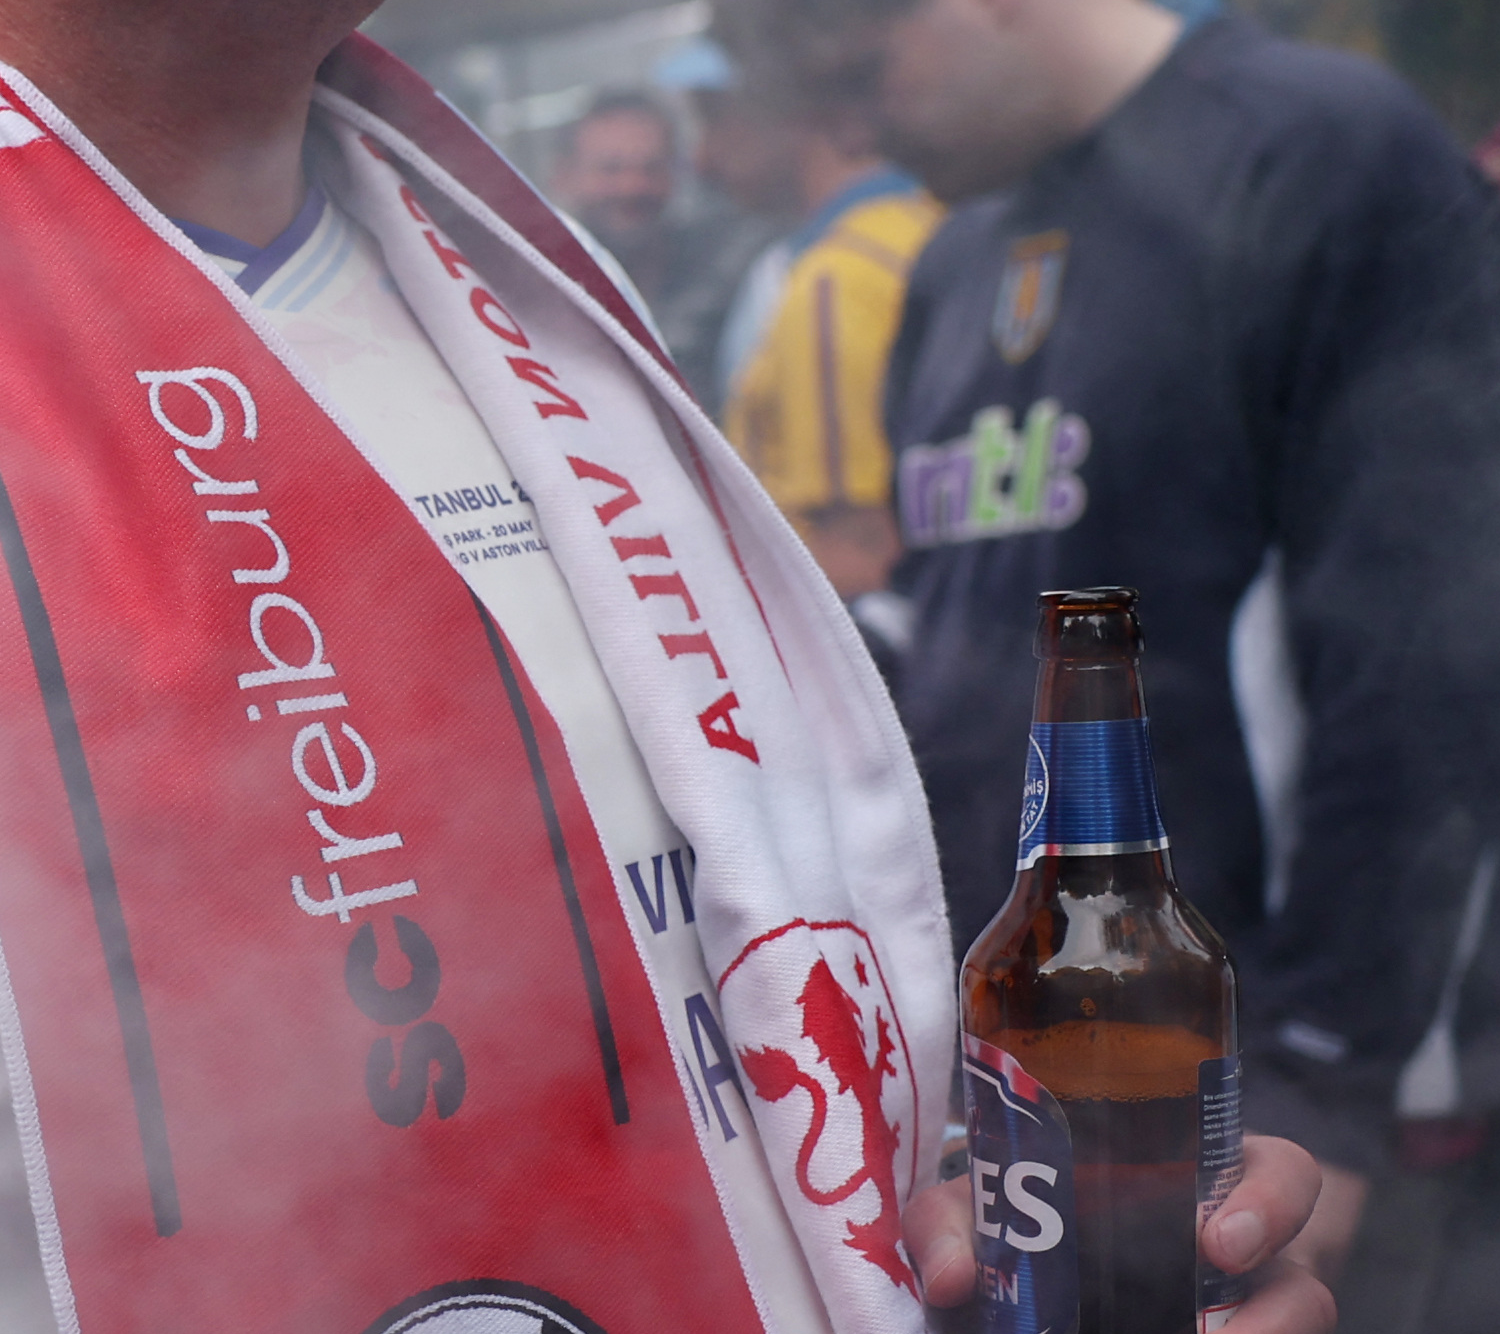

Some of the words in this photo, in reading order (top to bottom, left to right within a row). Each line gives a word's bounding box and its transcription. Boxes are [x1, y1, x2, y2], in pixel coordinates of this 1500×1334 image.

[414, 483, 513, 519] TANBUL
[453, 529, 485, 545] PARK
[492, 525, 508, 539] 20
[508, 519, 534, 535] MAY
[471, 548, 481, 563] V
[482, 542, 521, 562] ASTON
[520, 538, 550, 553] VILL
